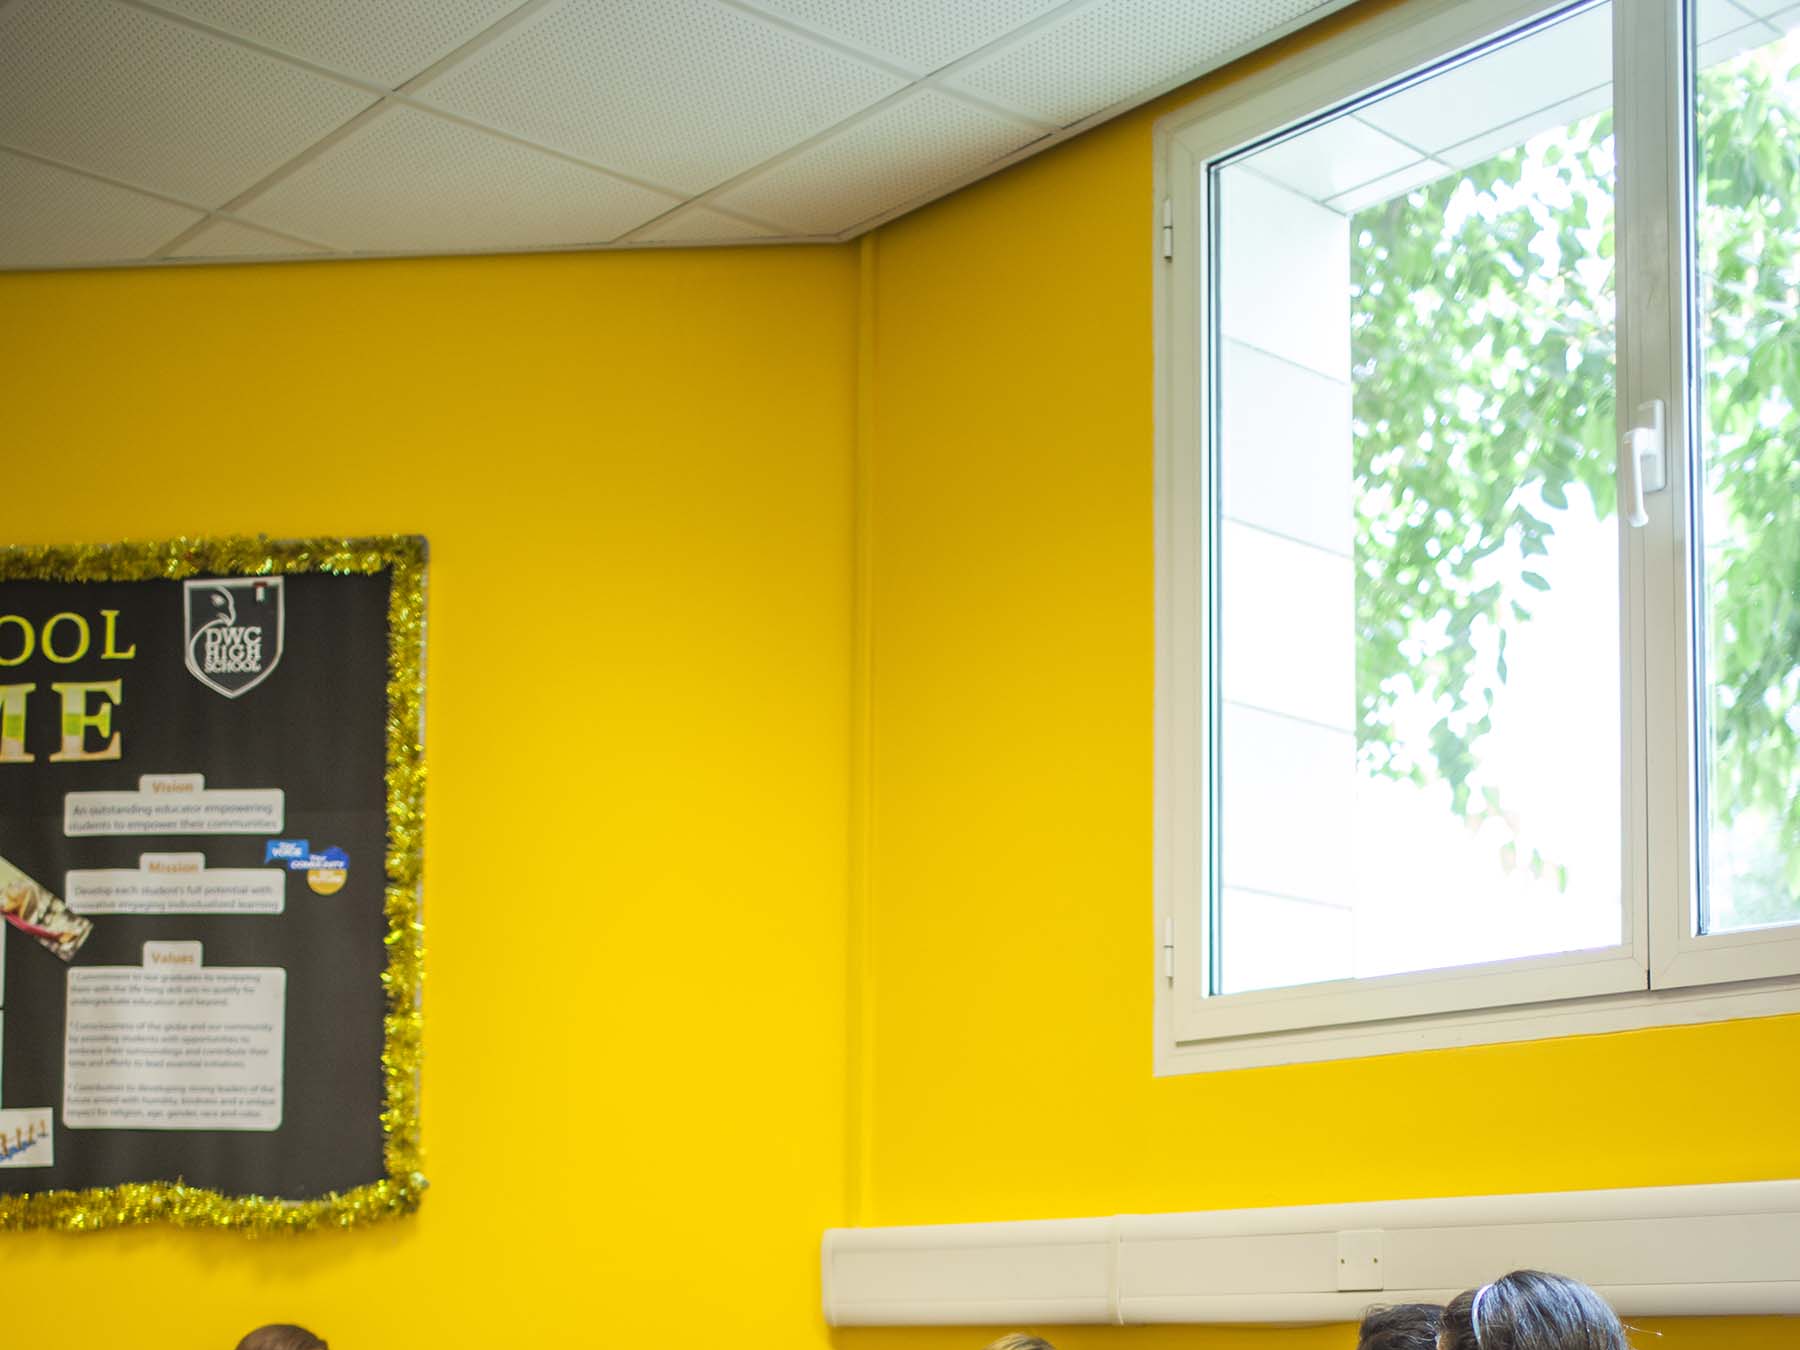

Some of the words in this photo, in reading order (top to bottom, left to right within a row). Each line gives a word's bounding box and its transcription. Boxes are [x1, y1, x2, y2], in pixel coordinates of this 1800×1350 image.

[206, 626, 262, 645] DWC
[206, 642, 262, 661] HIGH
[205, 659, 262, 673] SCHOOL
[152, 782, 193, 793] Vision
[151, 952, 194, 964] Values
